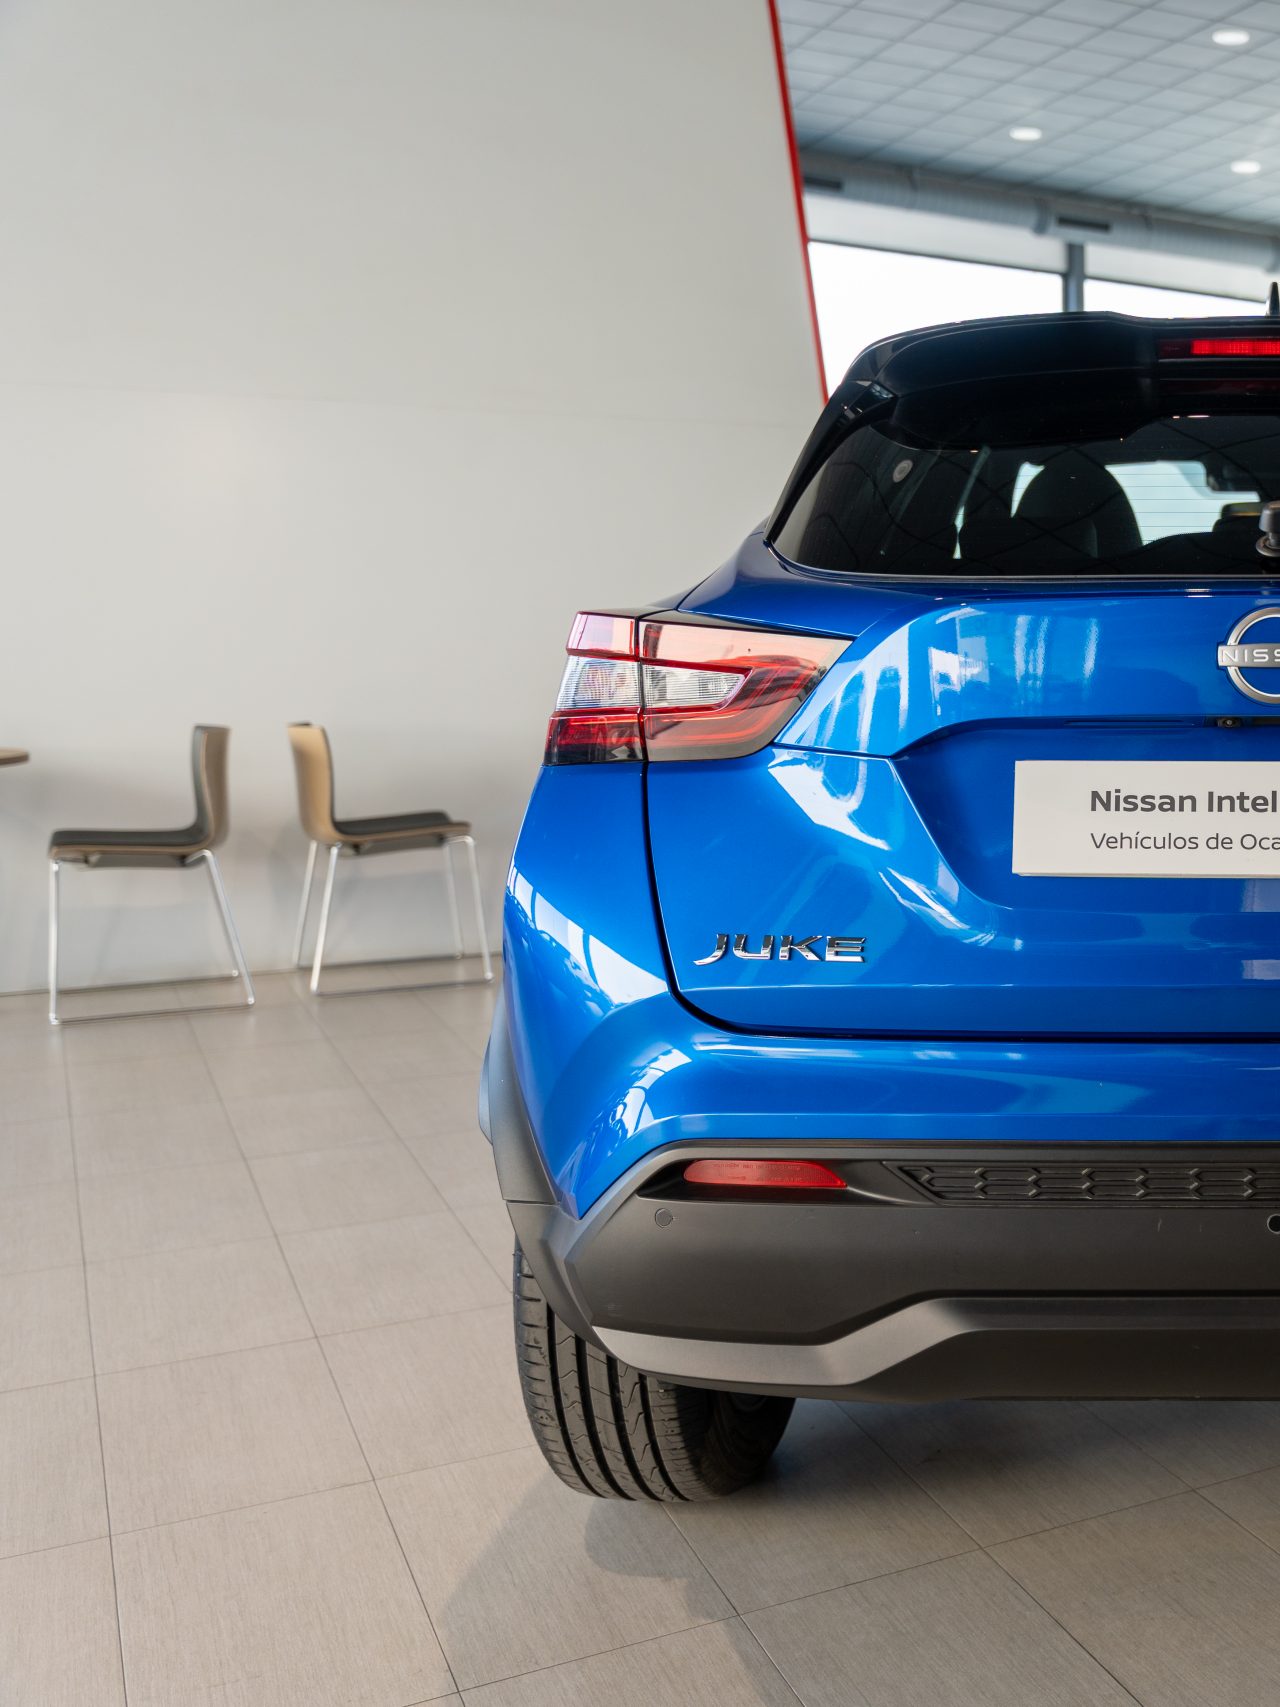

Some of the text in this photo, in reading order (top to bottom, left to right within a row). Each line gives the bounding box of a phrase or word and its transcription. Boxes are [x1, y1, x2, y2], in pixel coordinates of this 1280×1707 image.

[1090, 788, 1197, 813] Nissan
[1090, 831, 1199, 851] Vehículos
[1205, 832, 1233, 851] de
[693, 933, 867, 966] JUKE
